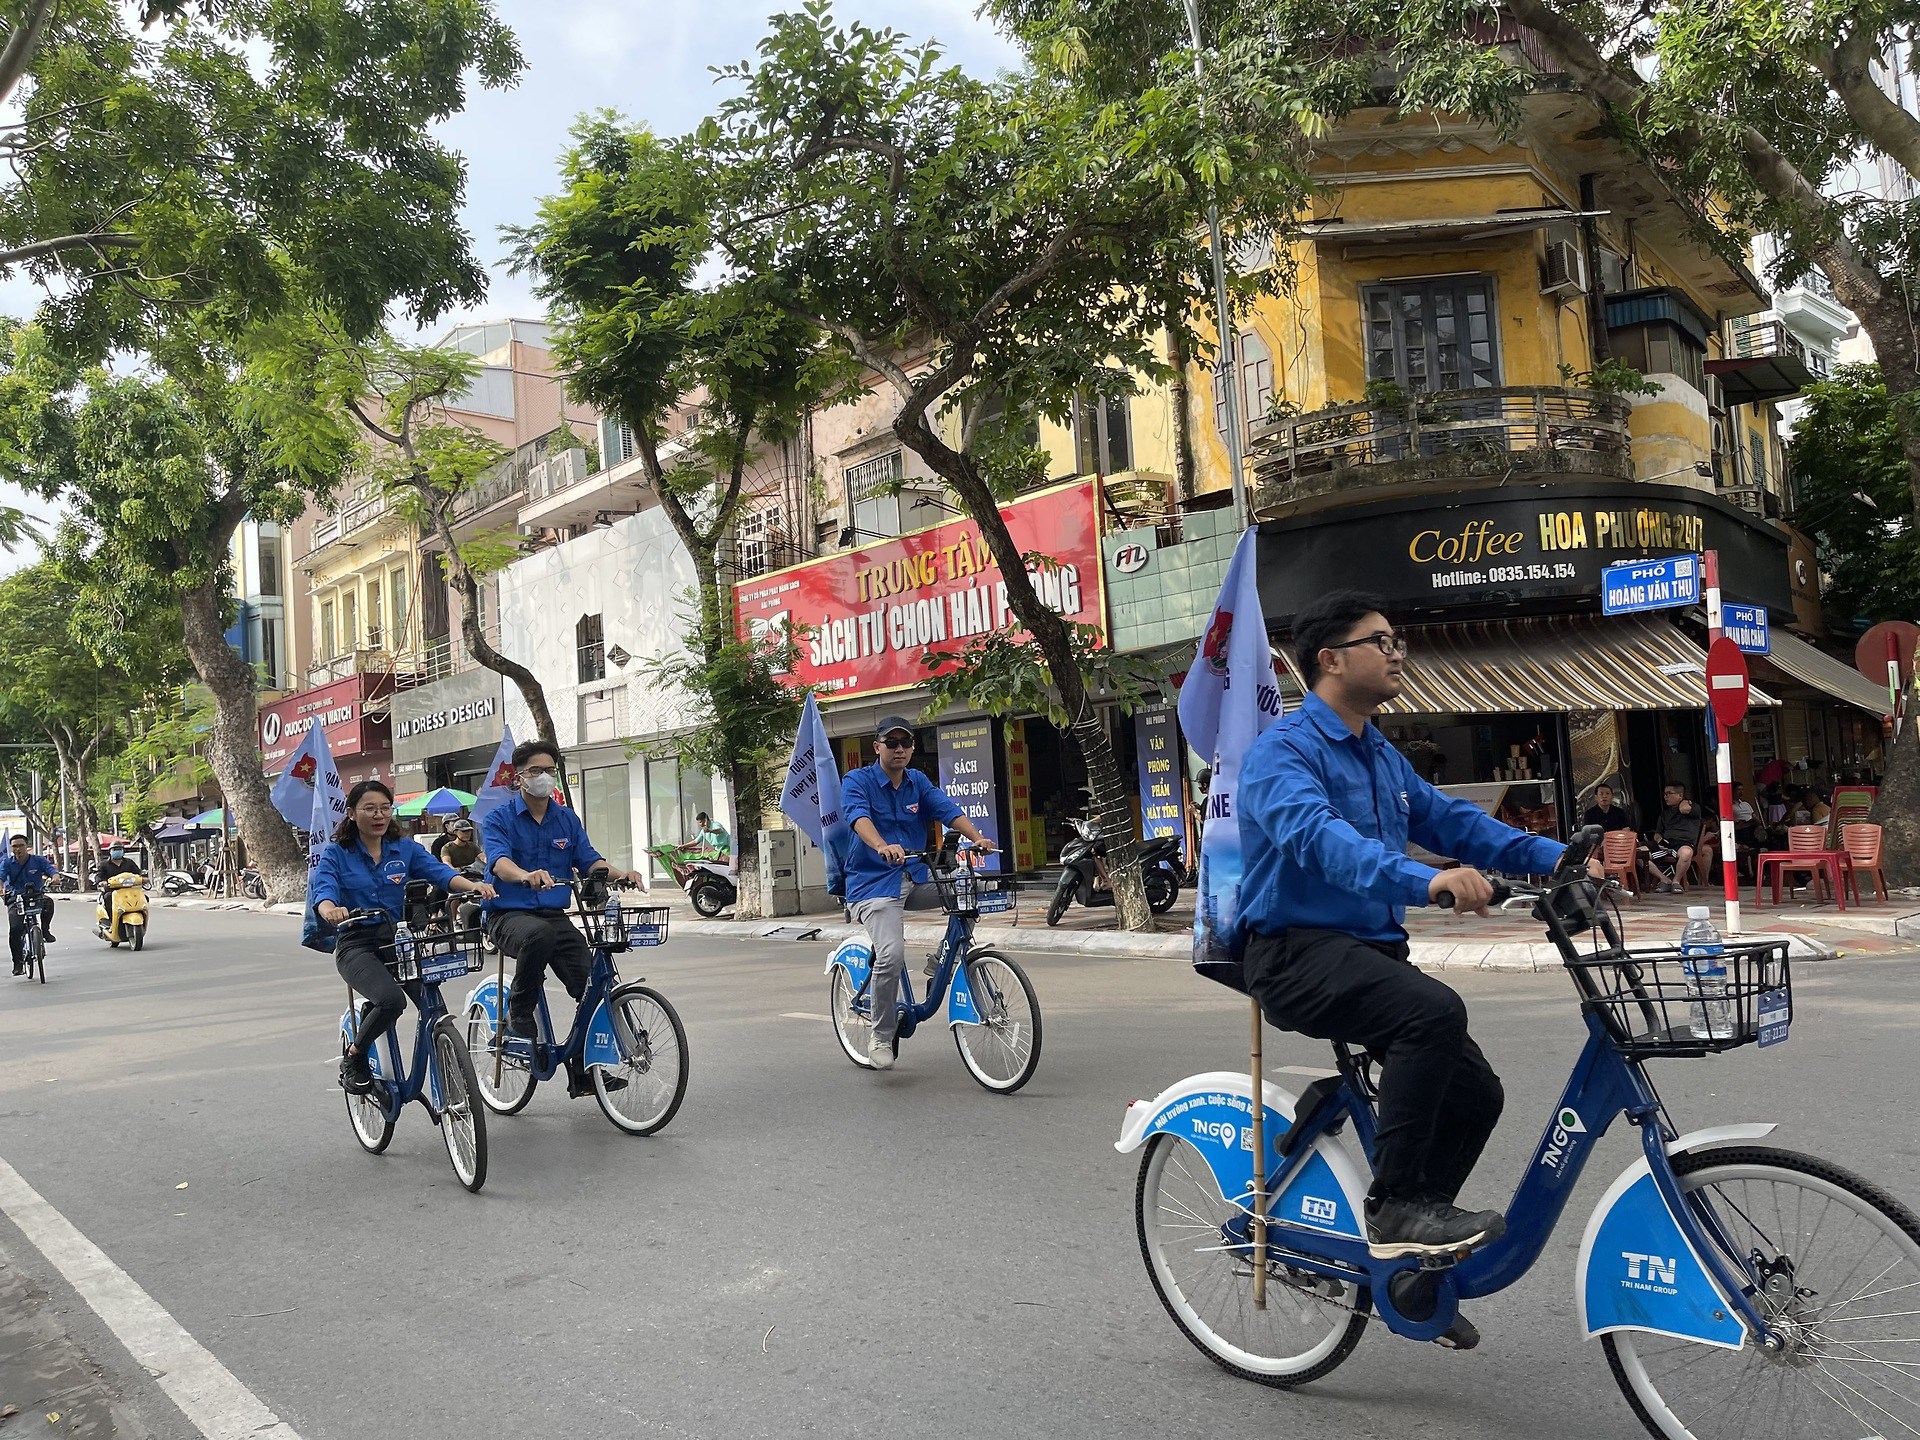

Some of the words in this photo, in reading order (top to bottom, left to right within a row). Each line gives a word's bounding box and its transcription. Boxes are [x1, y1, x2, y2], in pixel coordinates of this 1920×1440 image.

[1408, 519, 1524, 564] Coffee
[1538, 511, 1588, 551] HOA
[1595, 507, 1673, 555] PHƯỢNG
[855, 551, 937, 603] TRUNG
[943, 530, 999, 580] TÂM
[1431, 571, 1487, 589] Hotline:
[1488, 562, 1576, 583] 0835.154.154
[1631, 563, 1666, 580] PHỐ
[1609, 584, 1645, 607] HOÀNG
[1647, 580, 1670, 603] VĂN
[1671, 578, 1693, 601] THỤ
[808, 613, 859, 667] SÁCH
[890, 596, 947, 654] CHỌN
[951, 576, 992, 638] HẢI
[996, 563, 1081, 628] PÒNG
[1735, 609, 1754, 622] PHỐ
[326, 705, 353, 726] WATCH
[396, 720, 411, 739] JM
[412, 711, 446, 734] DRESS
[450, 698, 494, 725] DESIGN
[1149, 734, 1165, 751] VĂN
[954, 758, 978, 775] SÁCH
[1147, 756, 1171, 774] PHÒNG
[789, 778, 810, 799] VNPT
[945, 777, 970, 797] TỔNG
[971, 780, 989, 798] HỢP
[1151, 777, 1171, 798] PHẨM
[969, 801, 989, 818] HÓA
[1146, 803, 1161, 820] MÁY
[1161, 802, 1179, 819] TÍNH
[956, 991, 967, 1004] TN
[595, 1032, 609, 1045] TN
[1306, 1198, 1332, 1216] TN
[1621, 1251, 1676, 1284] TN
[1620, 1280, 1633, 1289] TRI
[1634, 1282, 1652, 1292] NAM
[1652, 1285, 1678, 1296] GROUP
